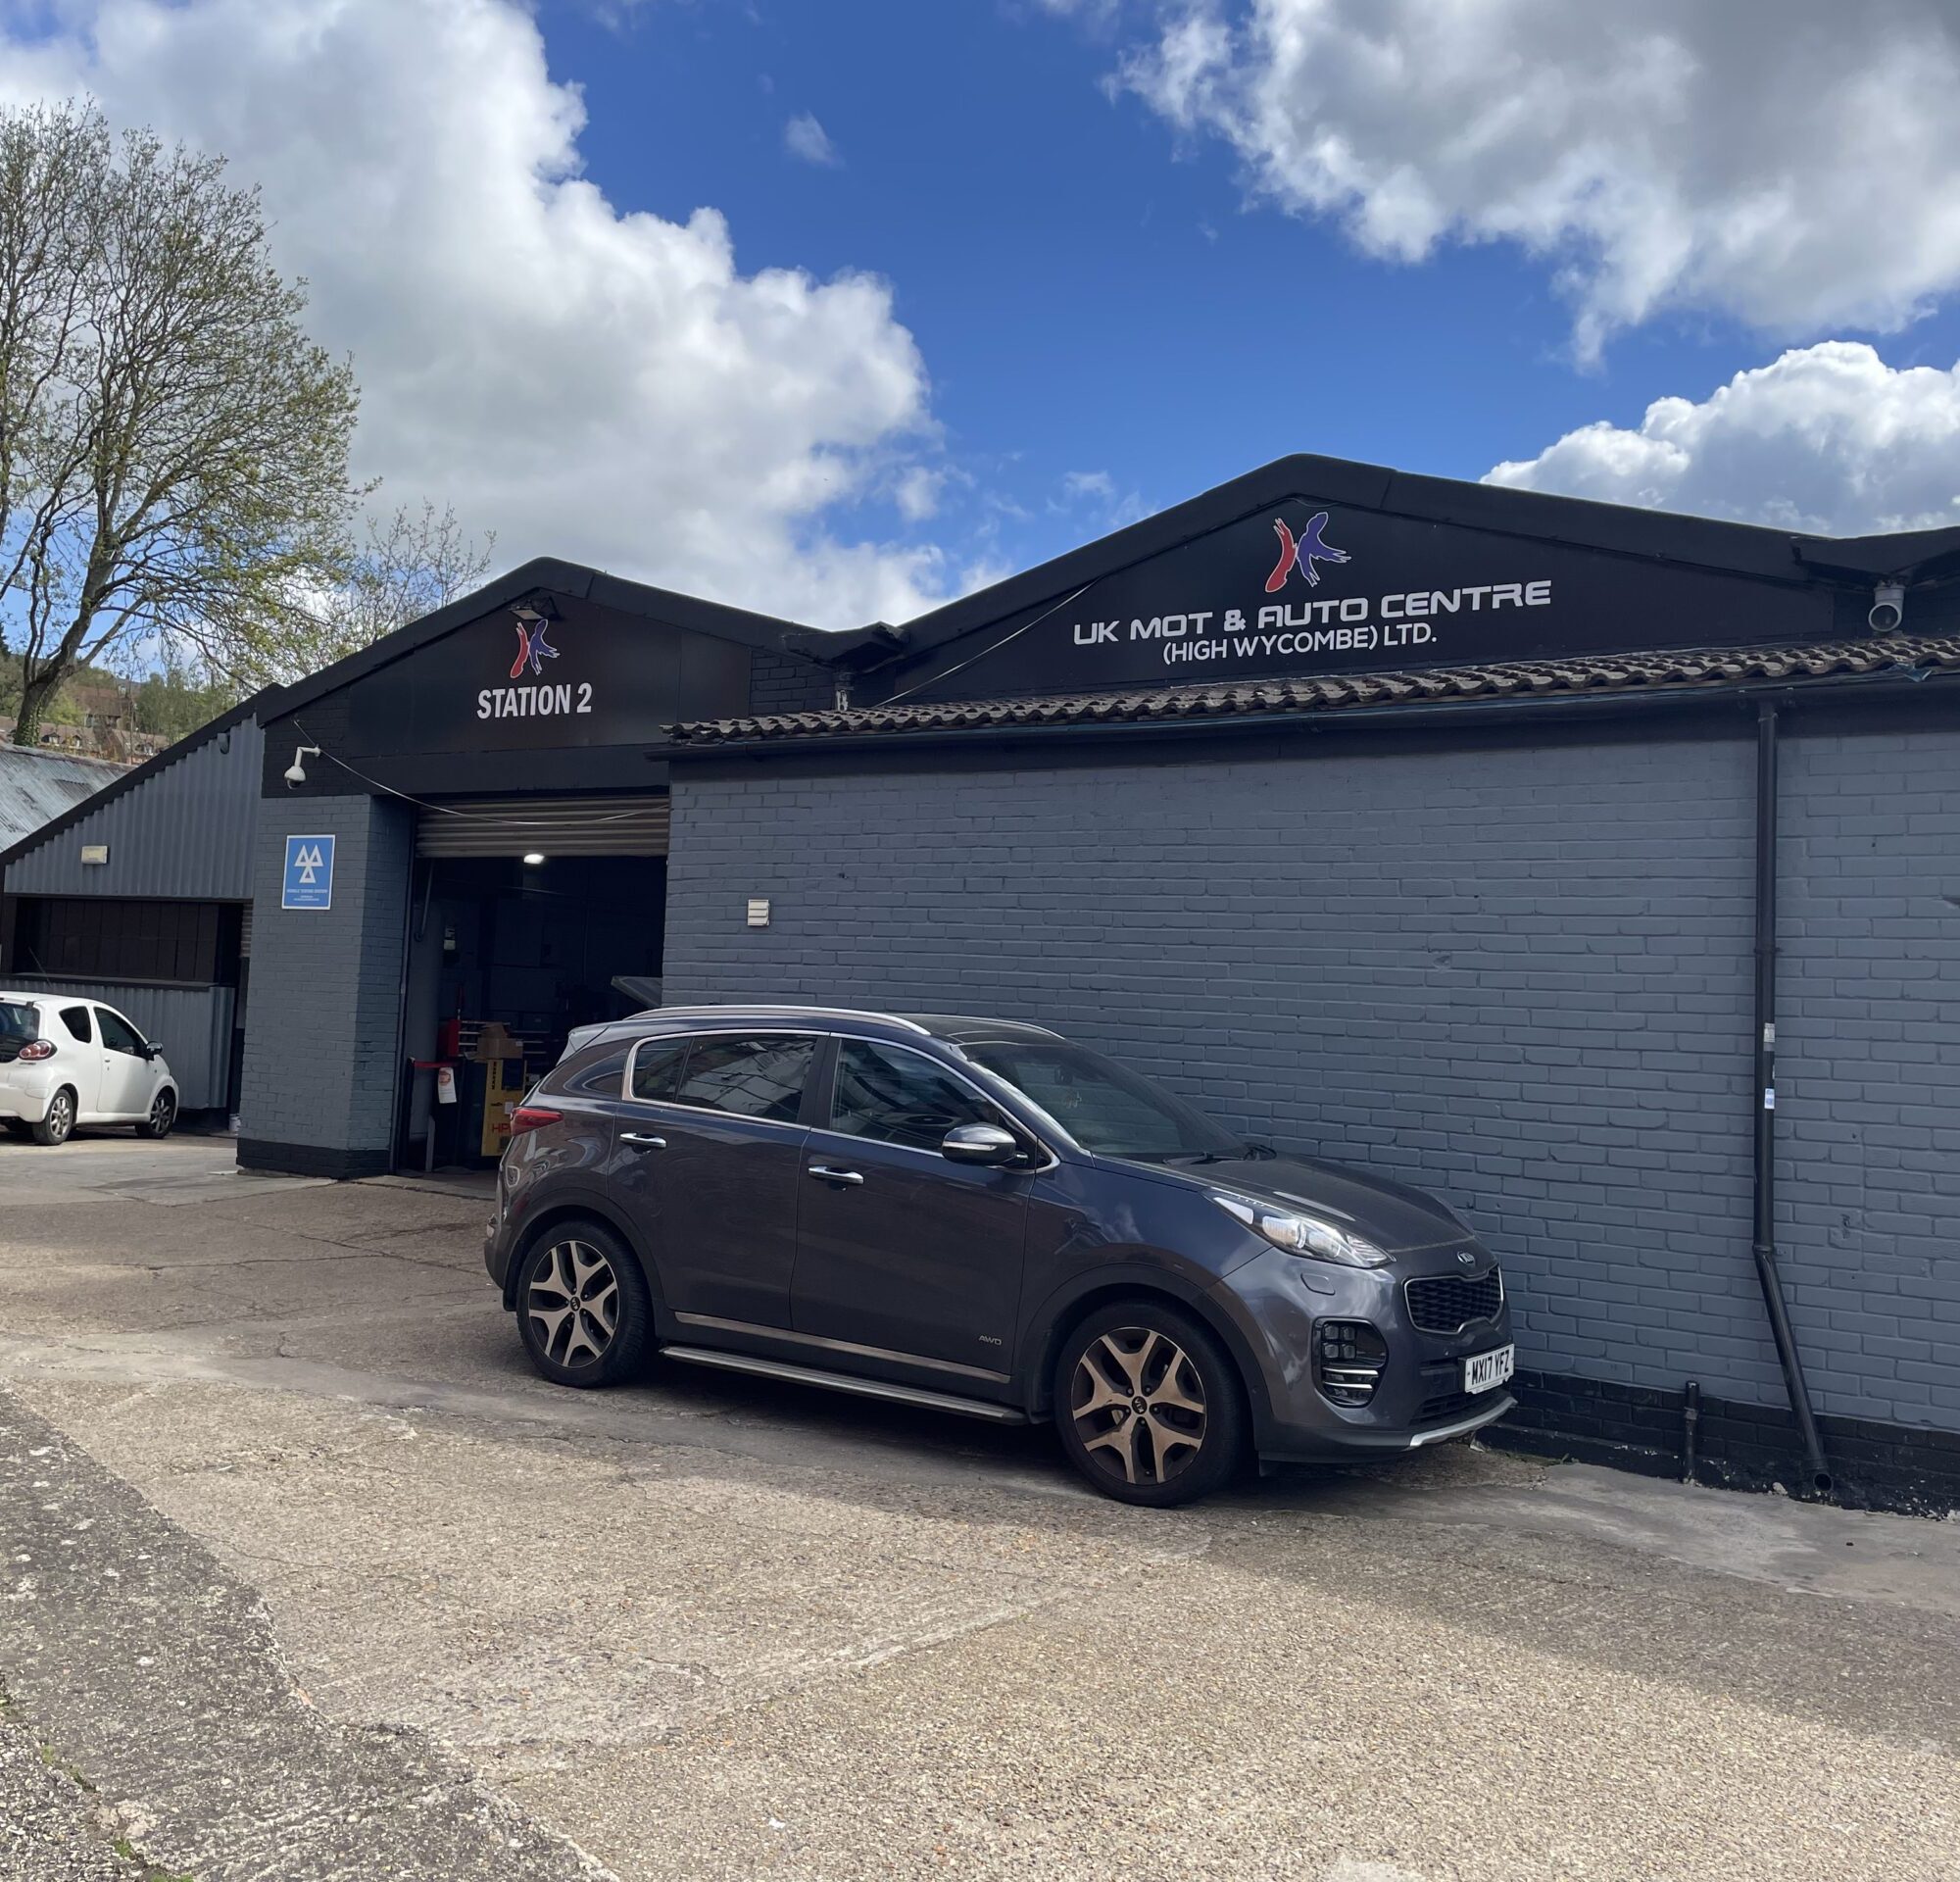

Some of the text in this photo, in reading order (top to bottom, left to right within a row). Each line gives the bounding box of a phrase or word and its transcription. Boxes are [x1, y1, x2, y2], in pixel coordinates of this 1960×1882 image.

[1074, 580, 1552, 645] UK MOT & AUTO CENTRE
[1163, 622, 1438, 666] (HIGH WYCOMBE) LTD.
[476, 682, 593, 719] STATION 2
[978, 1335, 1002, 1346] AWD
[1471, 1349, 1510, 1386] MX17 YFZ
